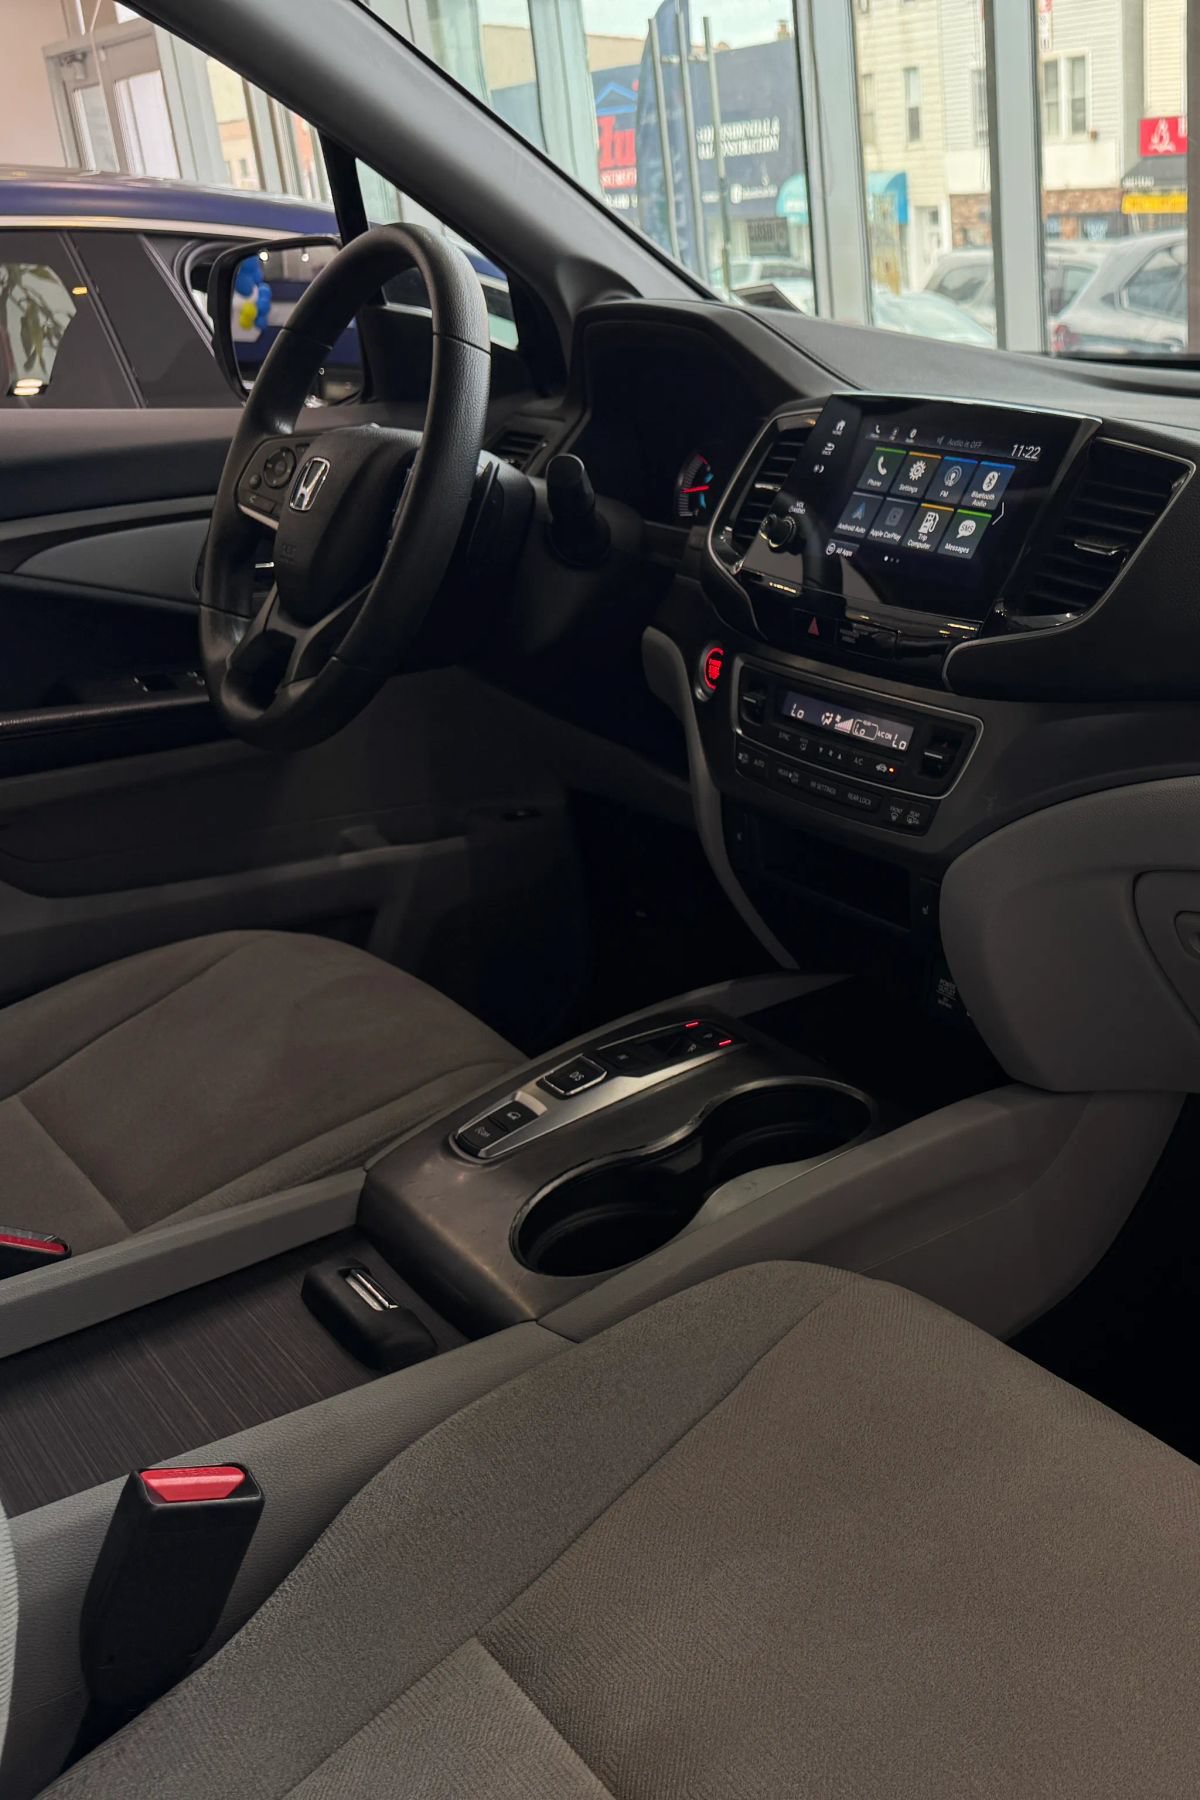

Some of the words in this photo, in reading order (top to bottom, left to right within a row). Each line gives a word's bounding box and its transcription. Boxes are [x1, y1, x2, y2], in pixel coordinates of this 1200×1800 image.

[1011, 444, 1041, 459] 11:22
[867, 479, 882, 487] Phone
[899, 484, 918, 494] Settings
[971, 490, 995, 500] Bluetooth
[972, 499, 987, 508] Audio
[837, 523, 855, 532] Android
[960, 524, 974, 533] SMS
[870, 528, 884, 538] Apple
[883, 531, 902, 541] CarPlay
[907, 540, 931, 550] Computer
[945, 543, 970, 554] Messages
[790, 703, 805, 719] Lo
[891, 733, 907, 750] Lo
